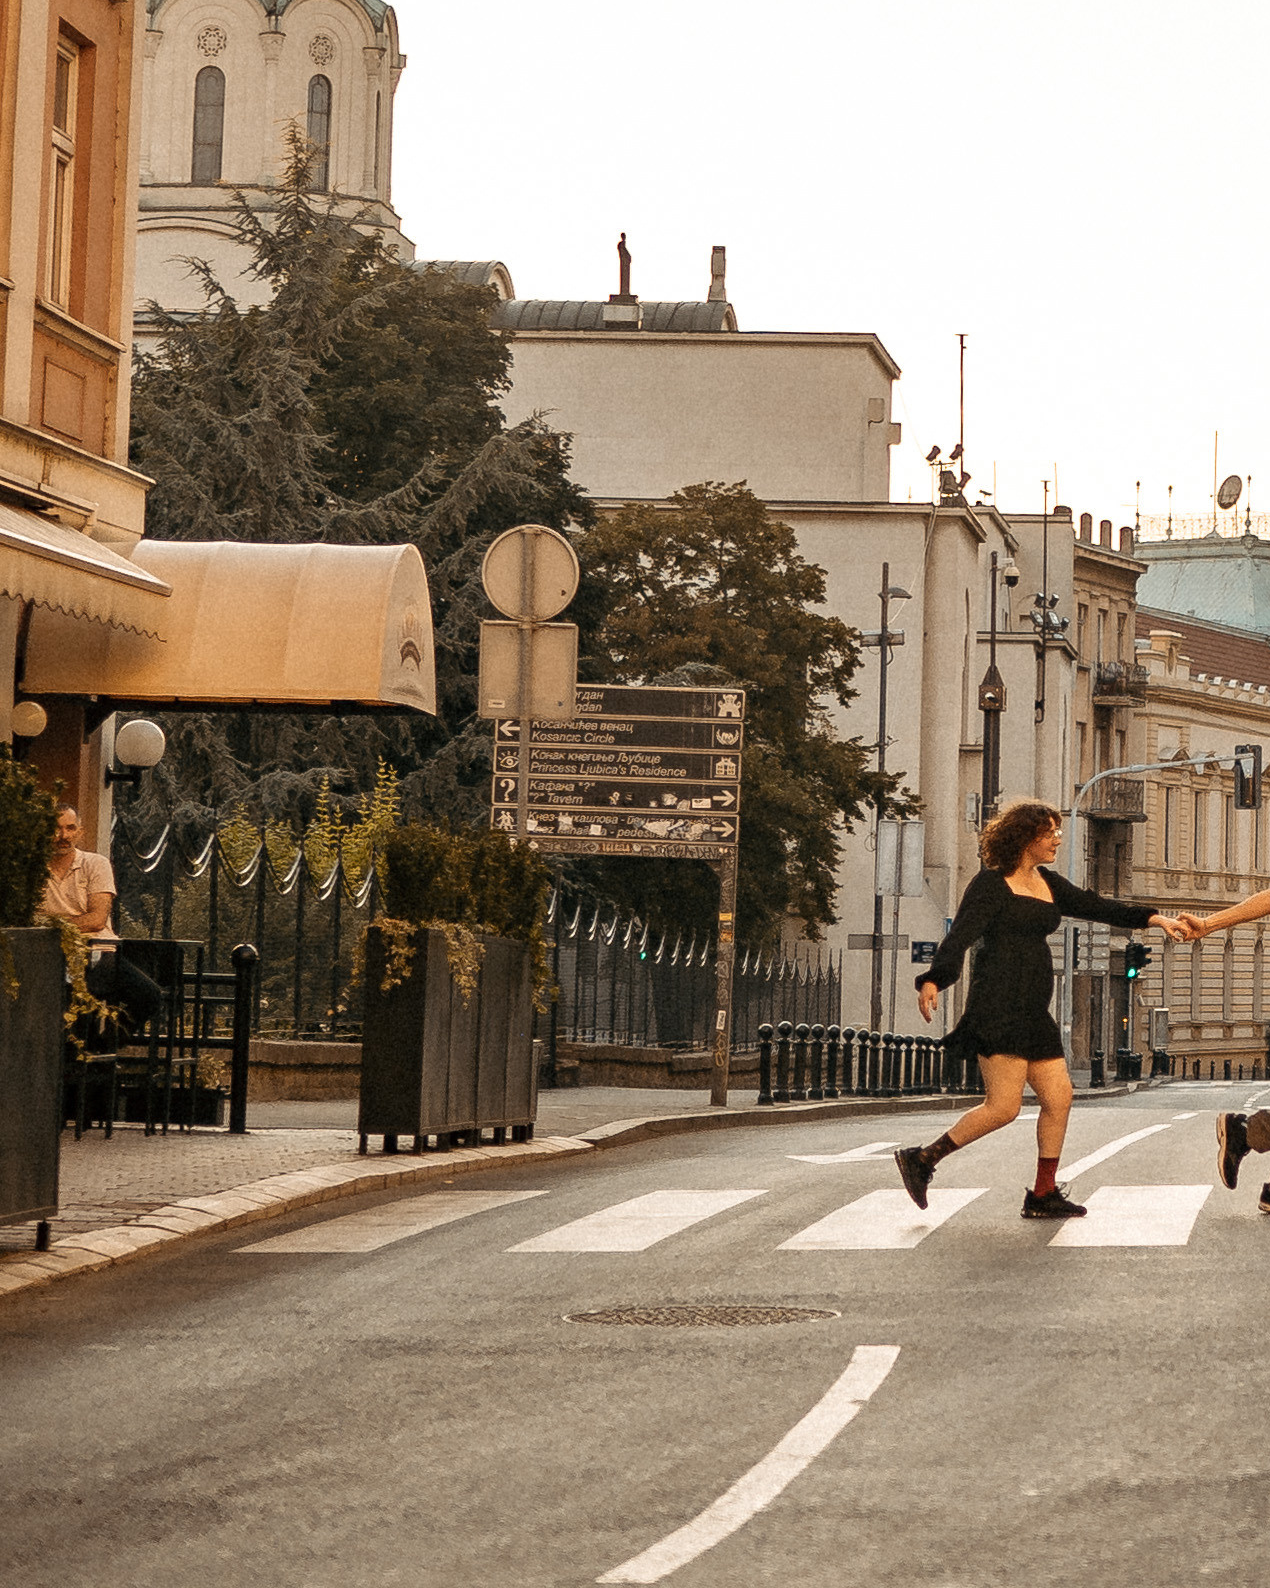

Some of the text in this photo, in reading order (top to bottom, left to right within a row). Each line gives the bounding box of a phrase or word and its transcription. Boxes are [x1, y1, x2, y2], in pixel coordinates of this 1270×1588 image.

[600, 723, 634, 734] венац
[584, 732, 615, 743] Circle
[531, 750, 565, 760] Конак
[531, 762, 687, 777] Princess Ljubica's Residence
[529, 780, 575, 792] Кафана
[547, 793, 583, 804] Tavern
